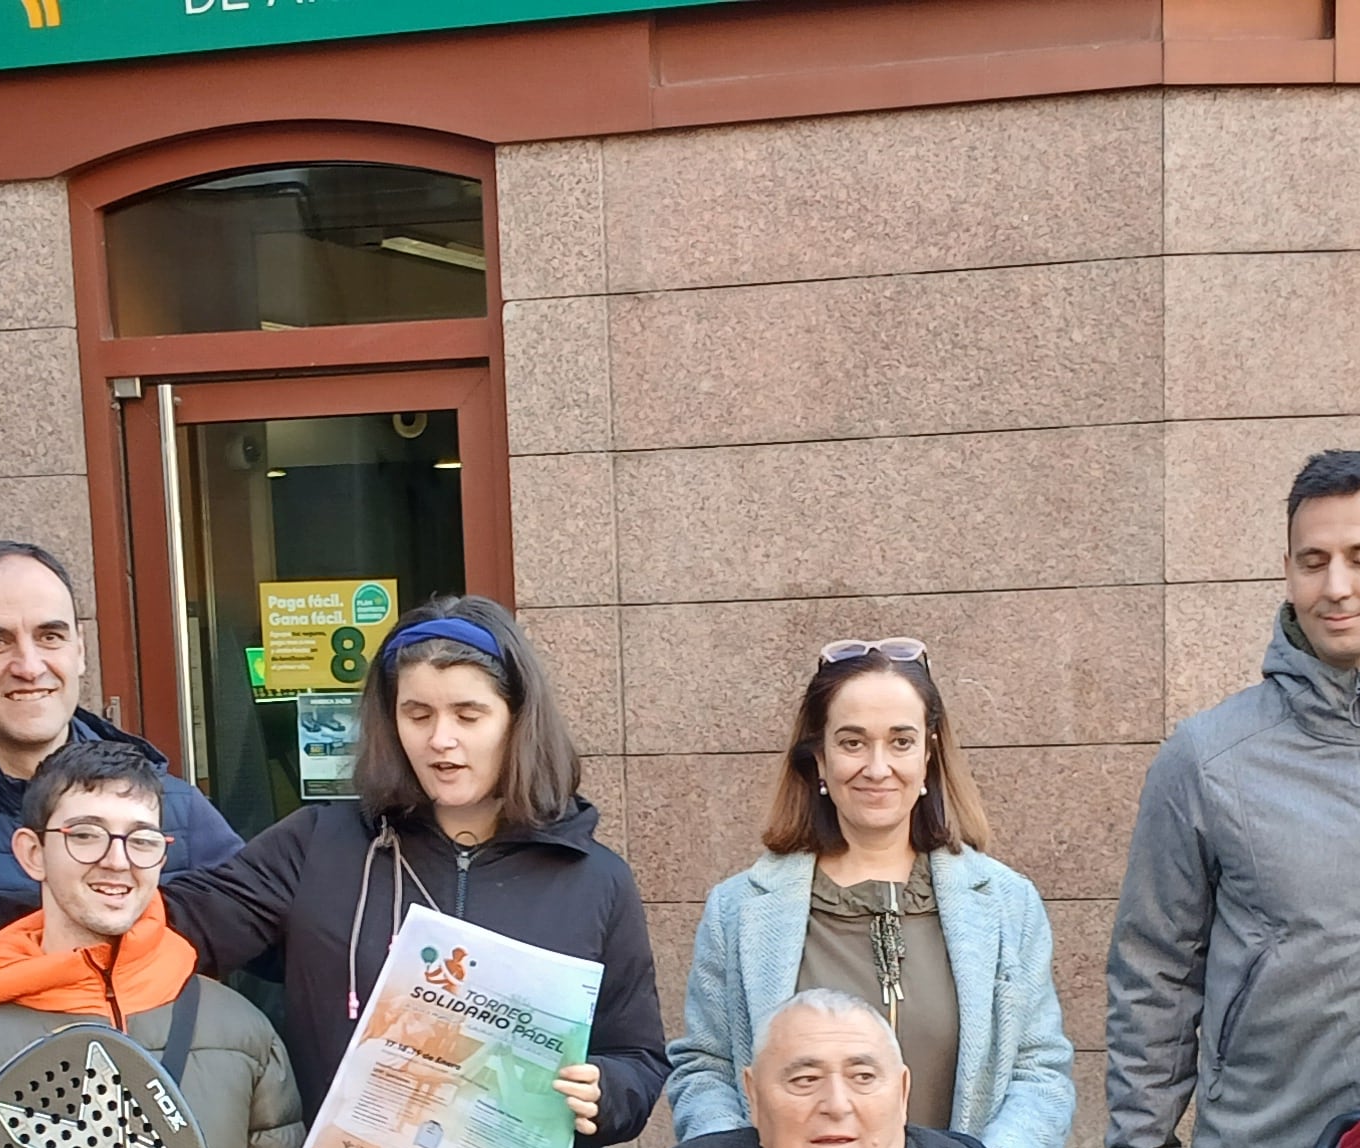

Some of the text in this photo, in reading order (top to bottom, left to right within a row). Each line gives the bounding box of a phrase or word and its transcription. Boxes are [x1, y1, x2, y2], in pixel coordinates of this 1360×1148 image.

[268, 595, 306, 612] Paga
[269, 612, 310, 626] Gana
[464, 988, 533, 1025] TORNEO
[410, 986, 511, 1029] SOLIDARIO
[512, 1023, 565, 1055] PÁDEL
